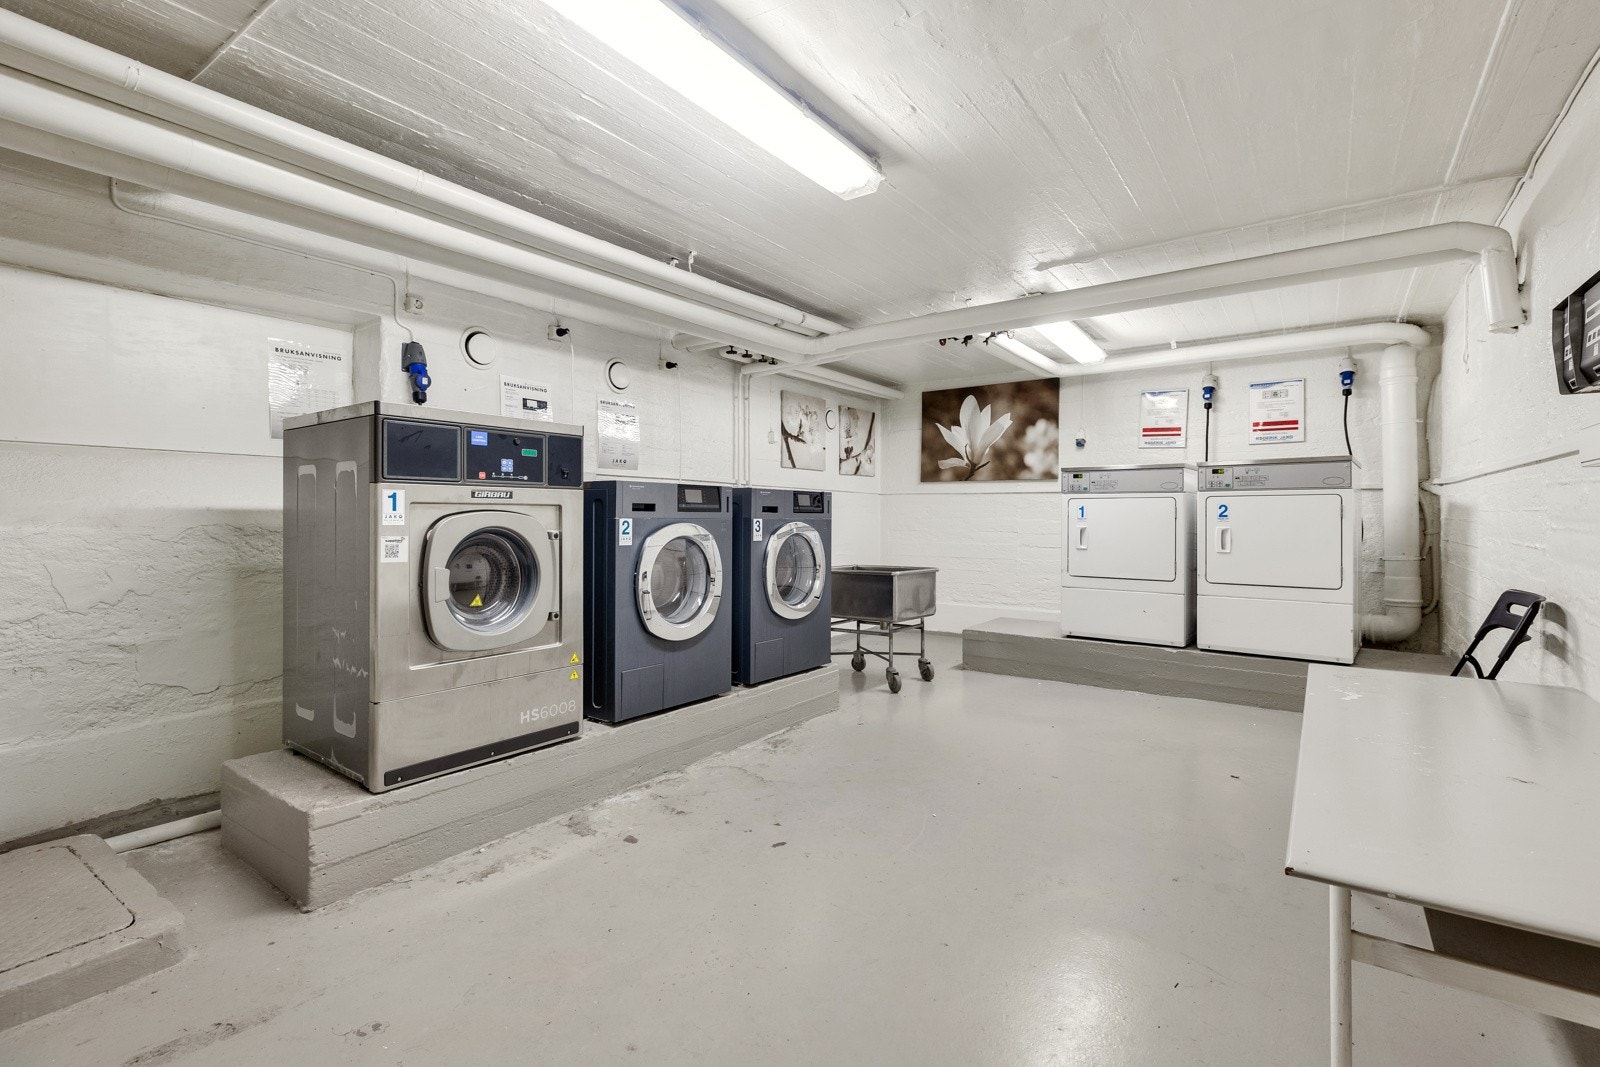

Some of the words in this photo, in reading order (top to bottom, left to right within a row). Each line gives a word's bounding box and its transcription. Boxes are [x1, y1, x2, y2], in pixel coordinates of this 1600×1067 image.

[274, 346, 342, 362] BRUKSANVISNING
[503, 381, 548, 394] BRUKSANVISNING
[387, 491, 398, 512] 1
[474, 490, 511, 499] GIRBAU
[1078, 506, 1085, 518] 1
[1217, 504, 1229, 518] 2
[621, 520, 631, 535] 2
[754, 520, 762, 533] 3
[520, 699, 577, 724] HS6008
